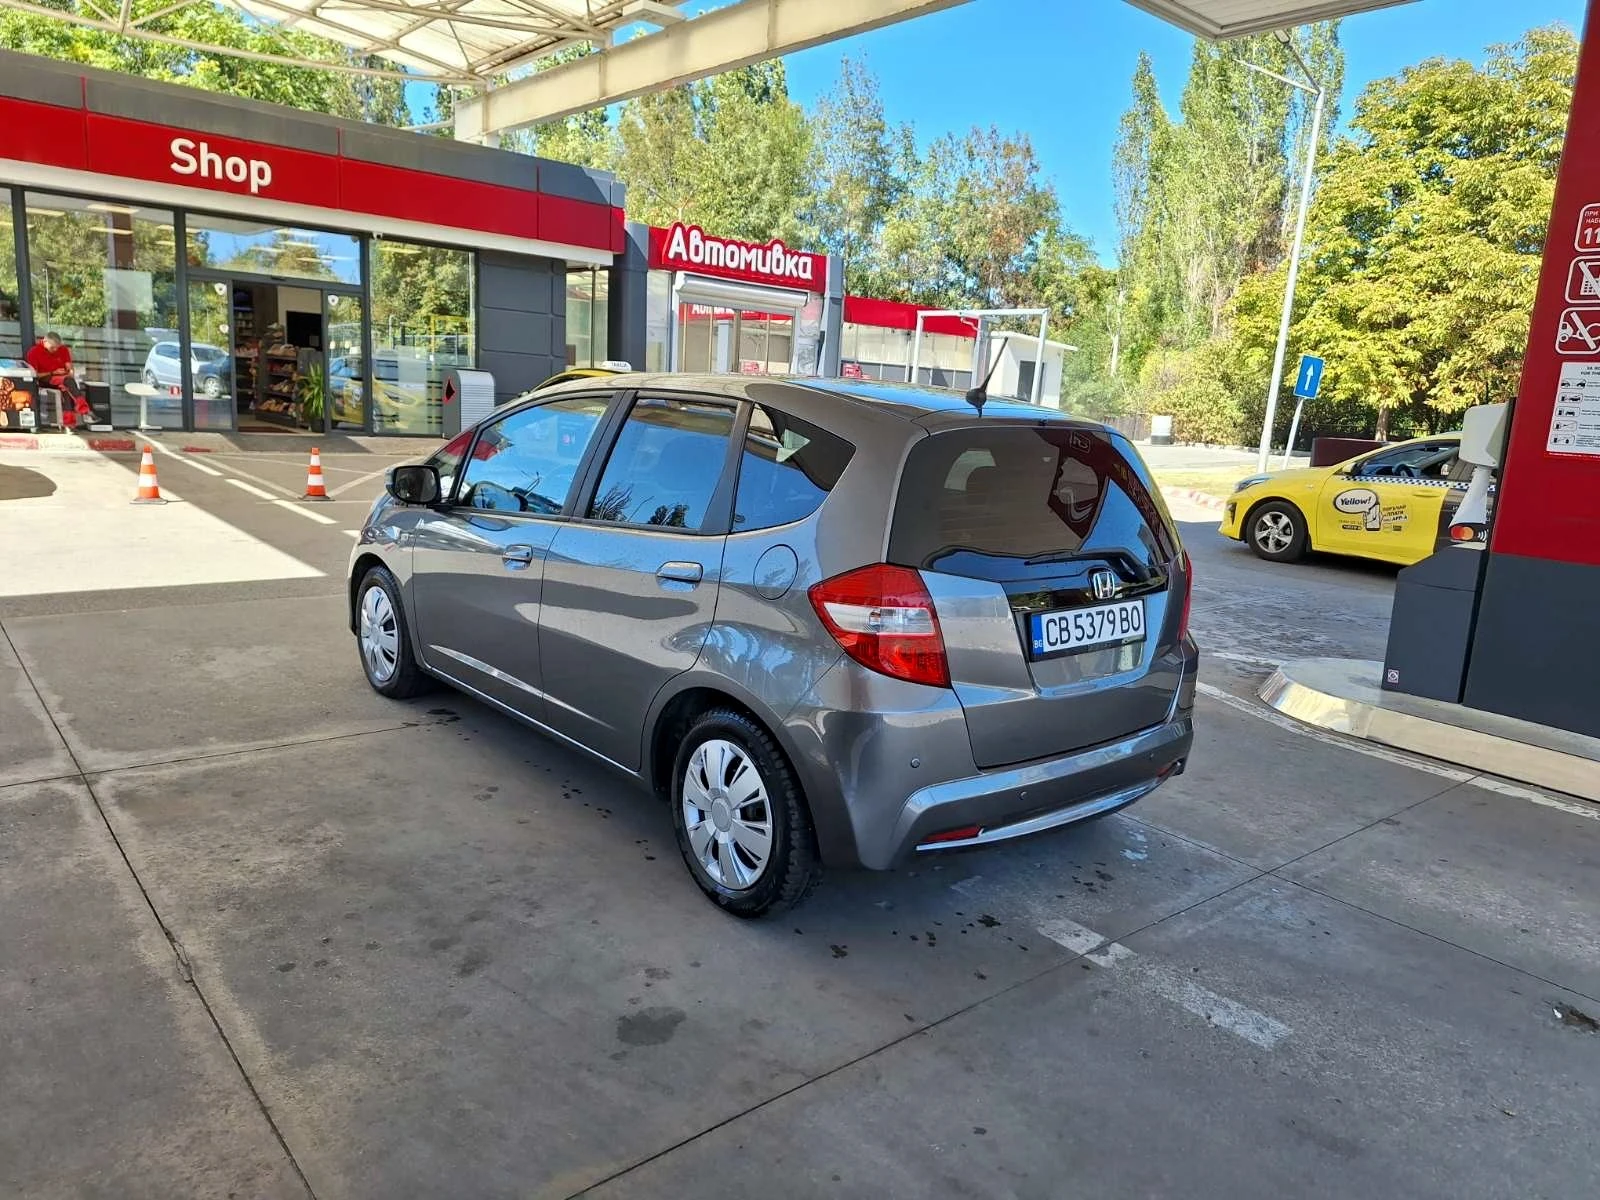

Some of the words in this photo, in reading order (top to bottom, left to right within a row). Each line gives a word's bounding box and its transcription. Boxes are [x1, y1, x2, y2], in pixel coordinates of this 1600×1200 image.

[170, 137, 272, 194] Shop
[668, 225, 813, 280] Автомивка
[1340, 496, 1372, 506] Yellow!
[1074, 609, 1116, 642] 5379
[1033, 639, 1043, 649] BG
